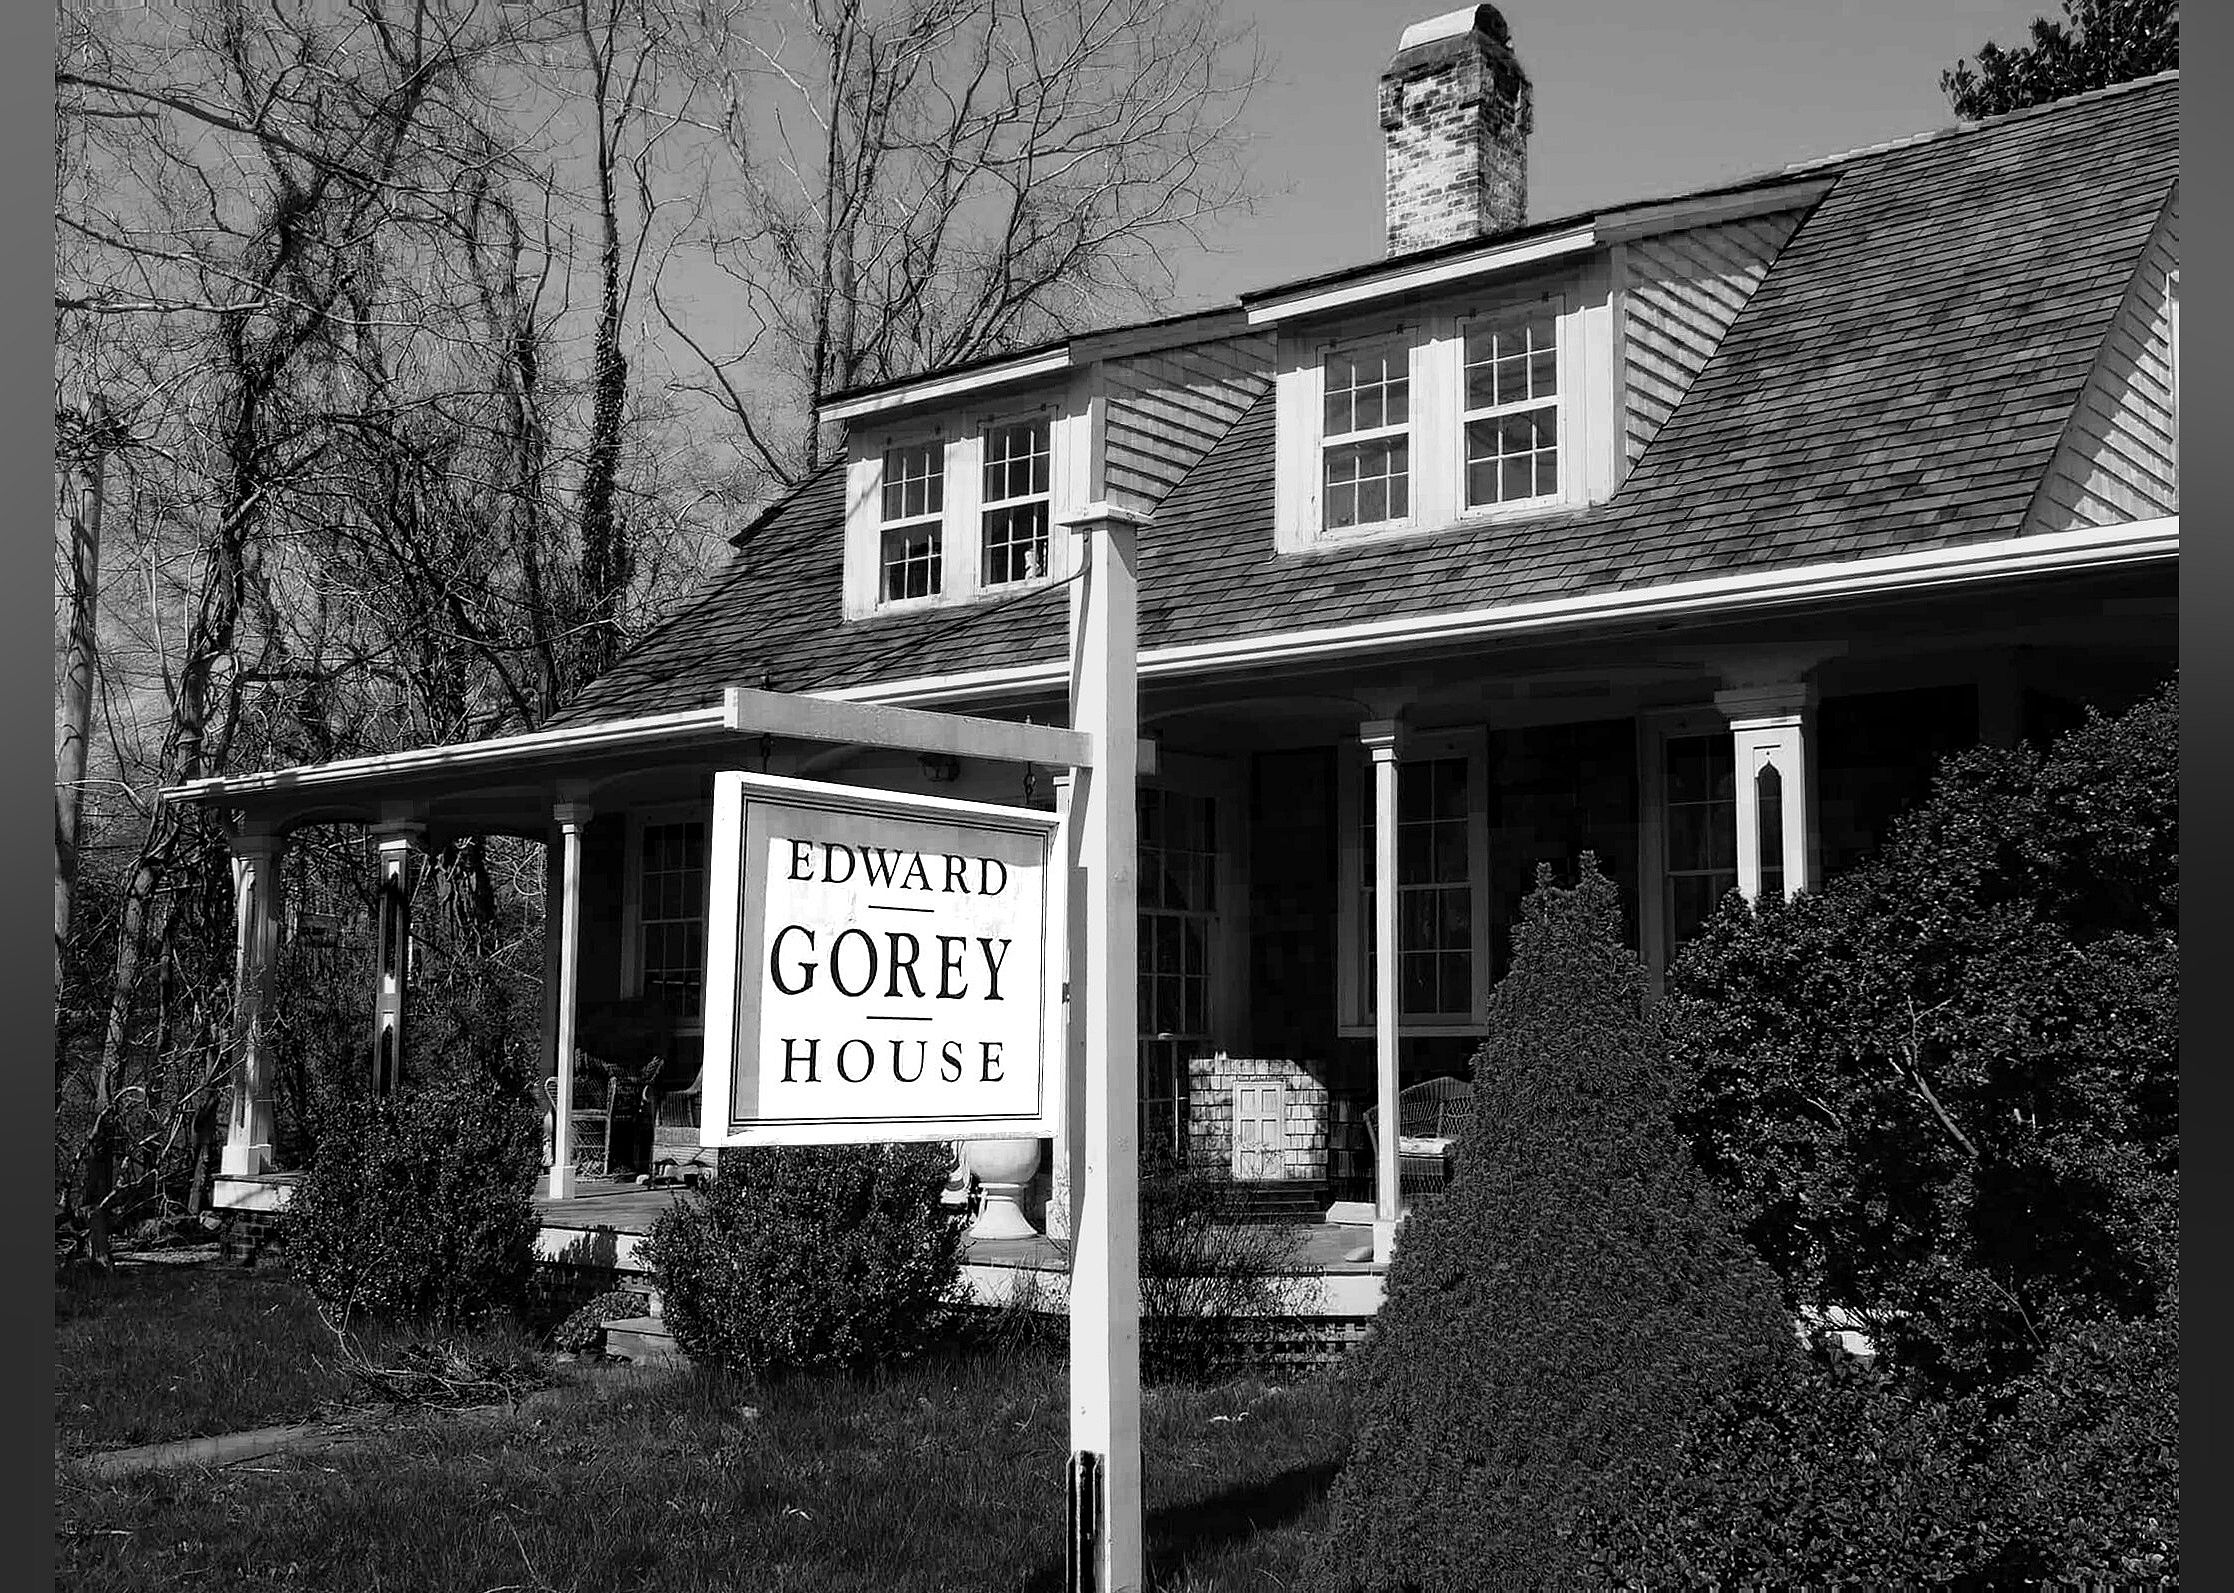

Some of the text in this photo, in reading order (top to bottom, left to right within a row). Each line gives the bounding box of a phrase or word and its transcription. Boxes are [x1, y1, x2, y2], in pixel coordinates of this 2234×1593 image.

[786, 838, 1008, 896] EDWARD
[770, 924, 1012, 1001] GOREY
[780, 1038, 1005, 1083] HOUSE
